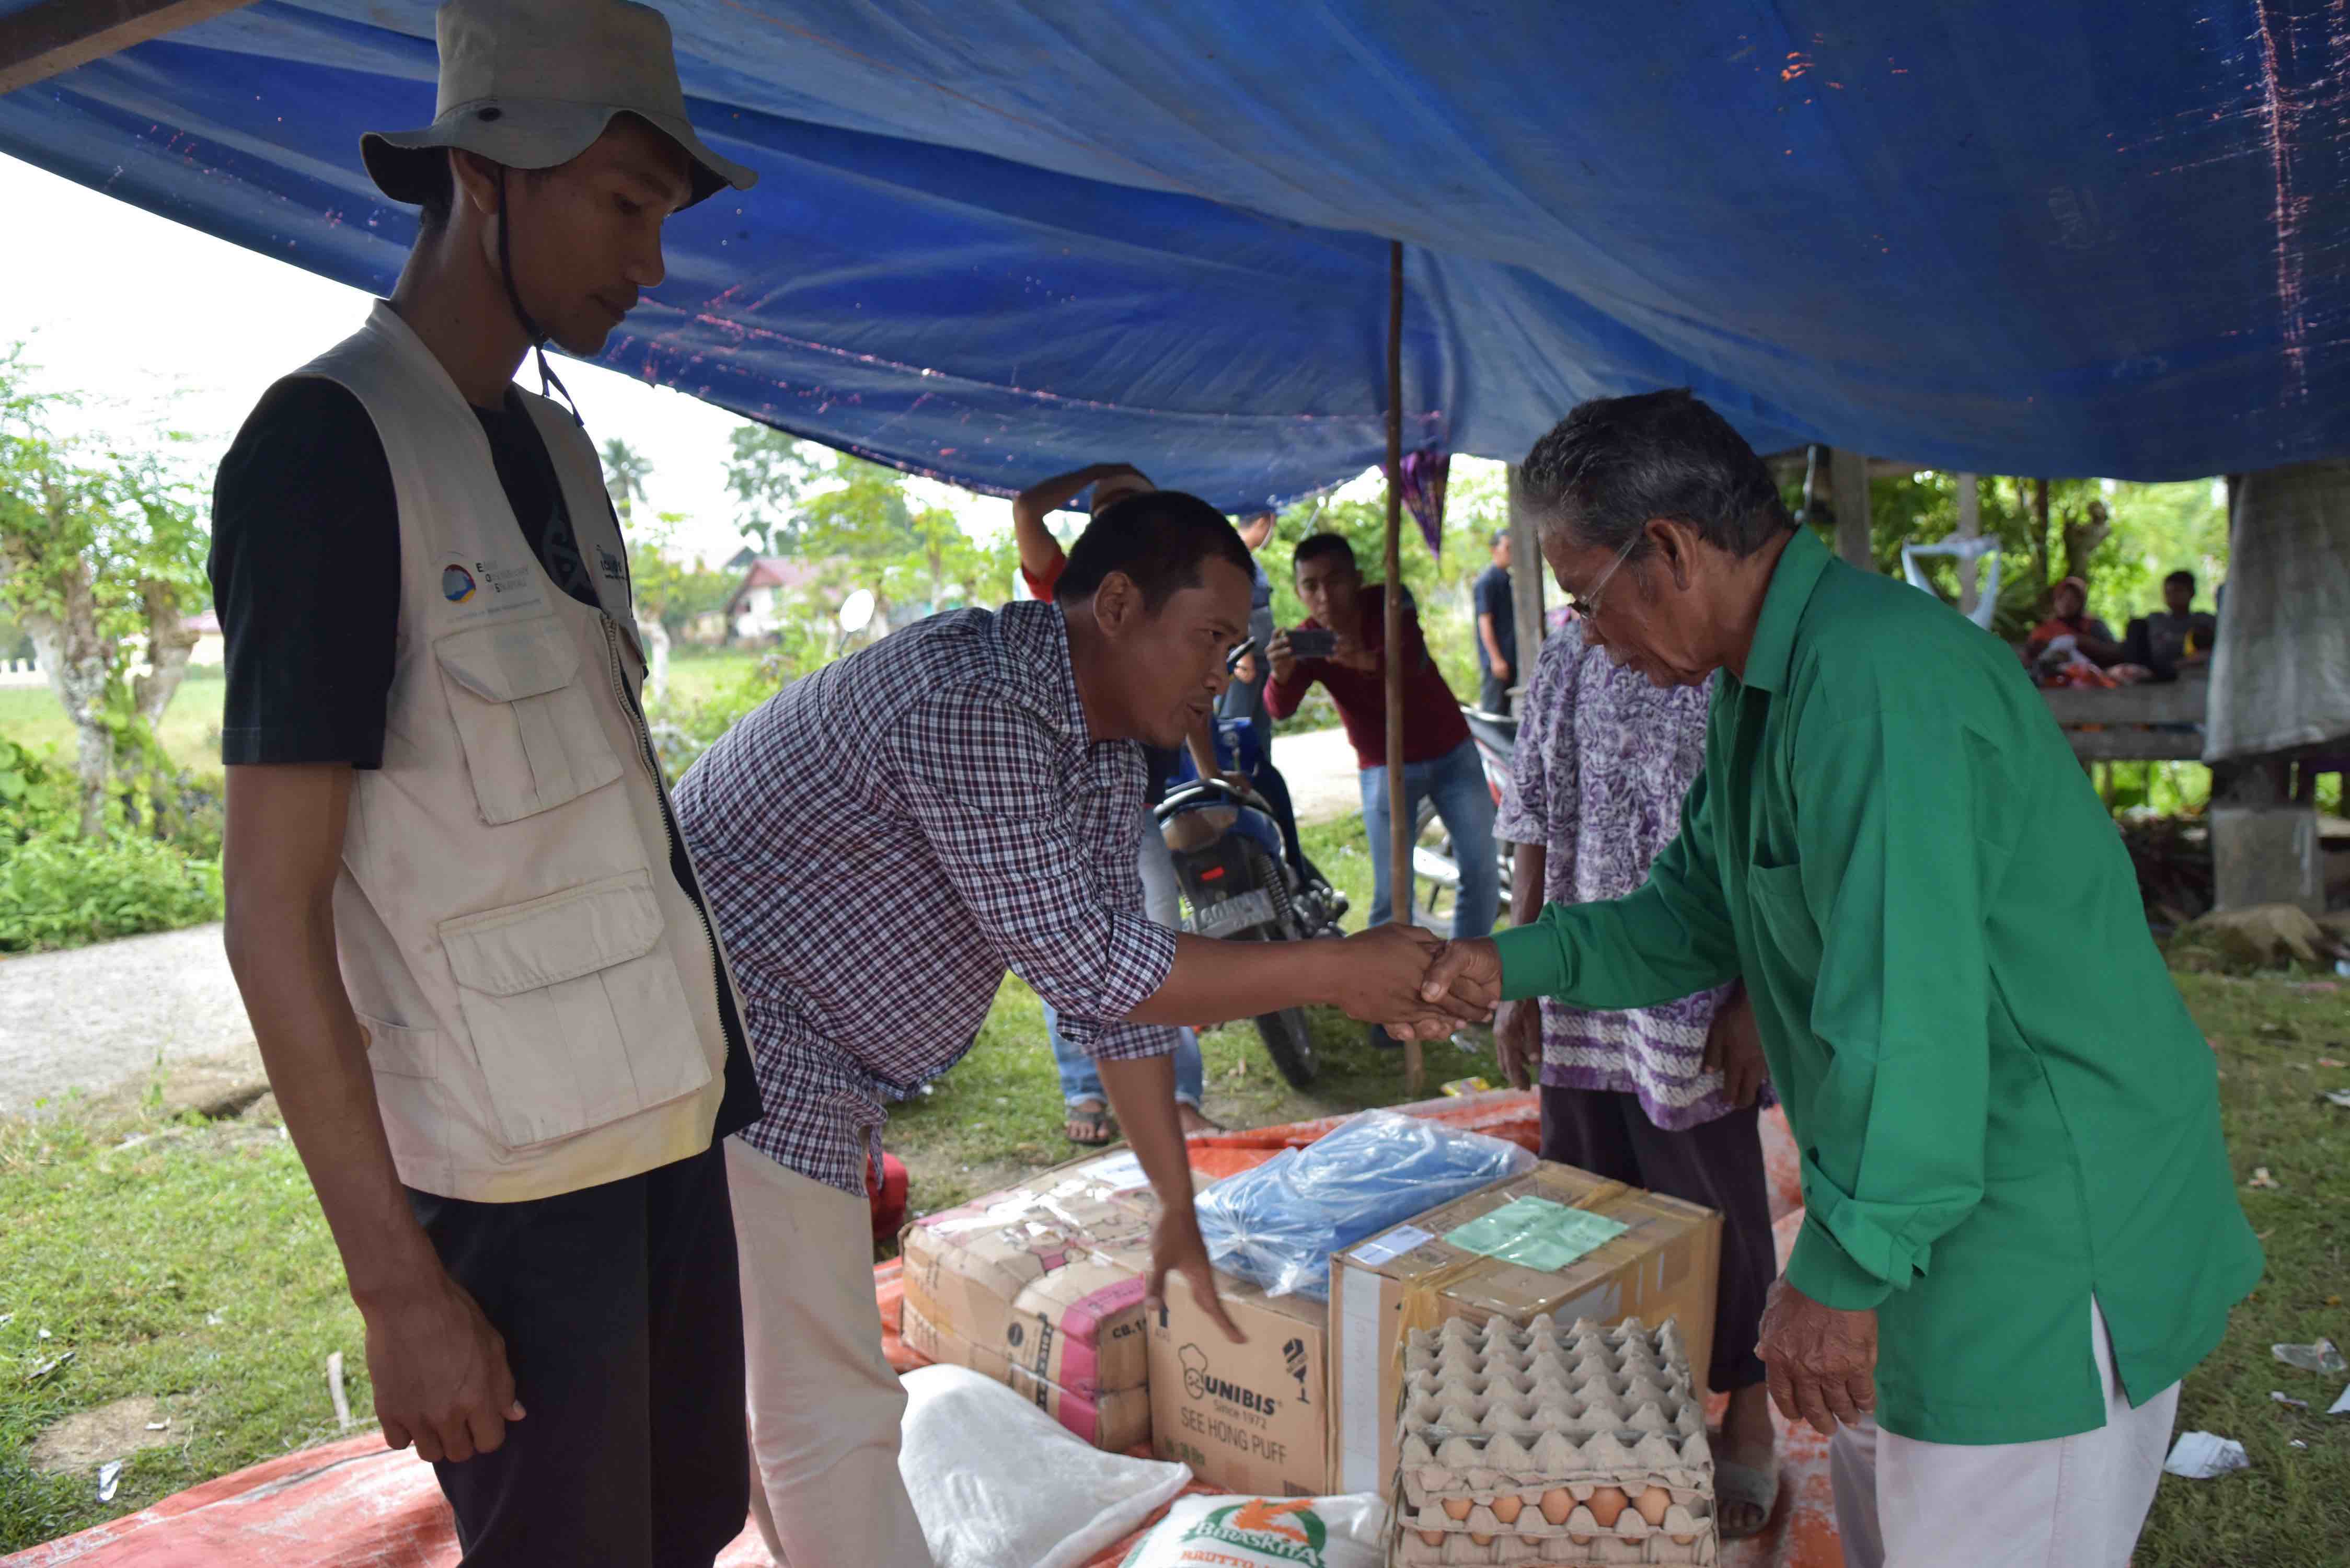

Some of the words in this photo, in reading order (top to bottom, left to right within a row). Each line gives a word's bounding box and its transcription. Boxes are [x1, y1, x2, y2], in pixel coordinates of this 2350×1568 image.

[1112, 1317, 1146, 1339] CB.1
[1204, 1375, 1275, 1415] UNIBIS
[1181, 1406, 1205, 1434] SEE
[1208, 1417, 1248, 1451] HONG
[1252, 1435, 1287, 1464] PUFF
